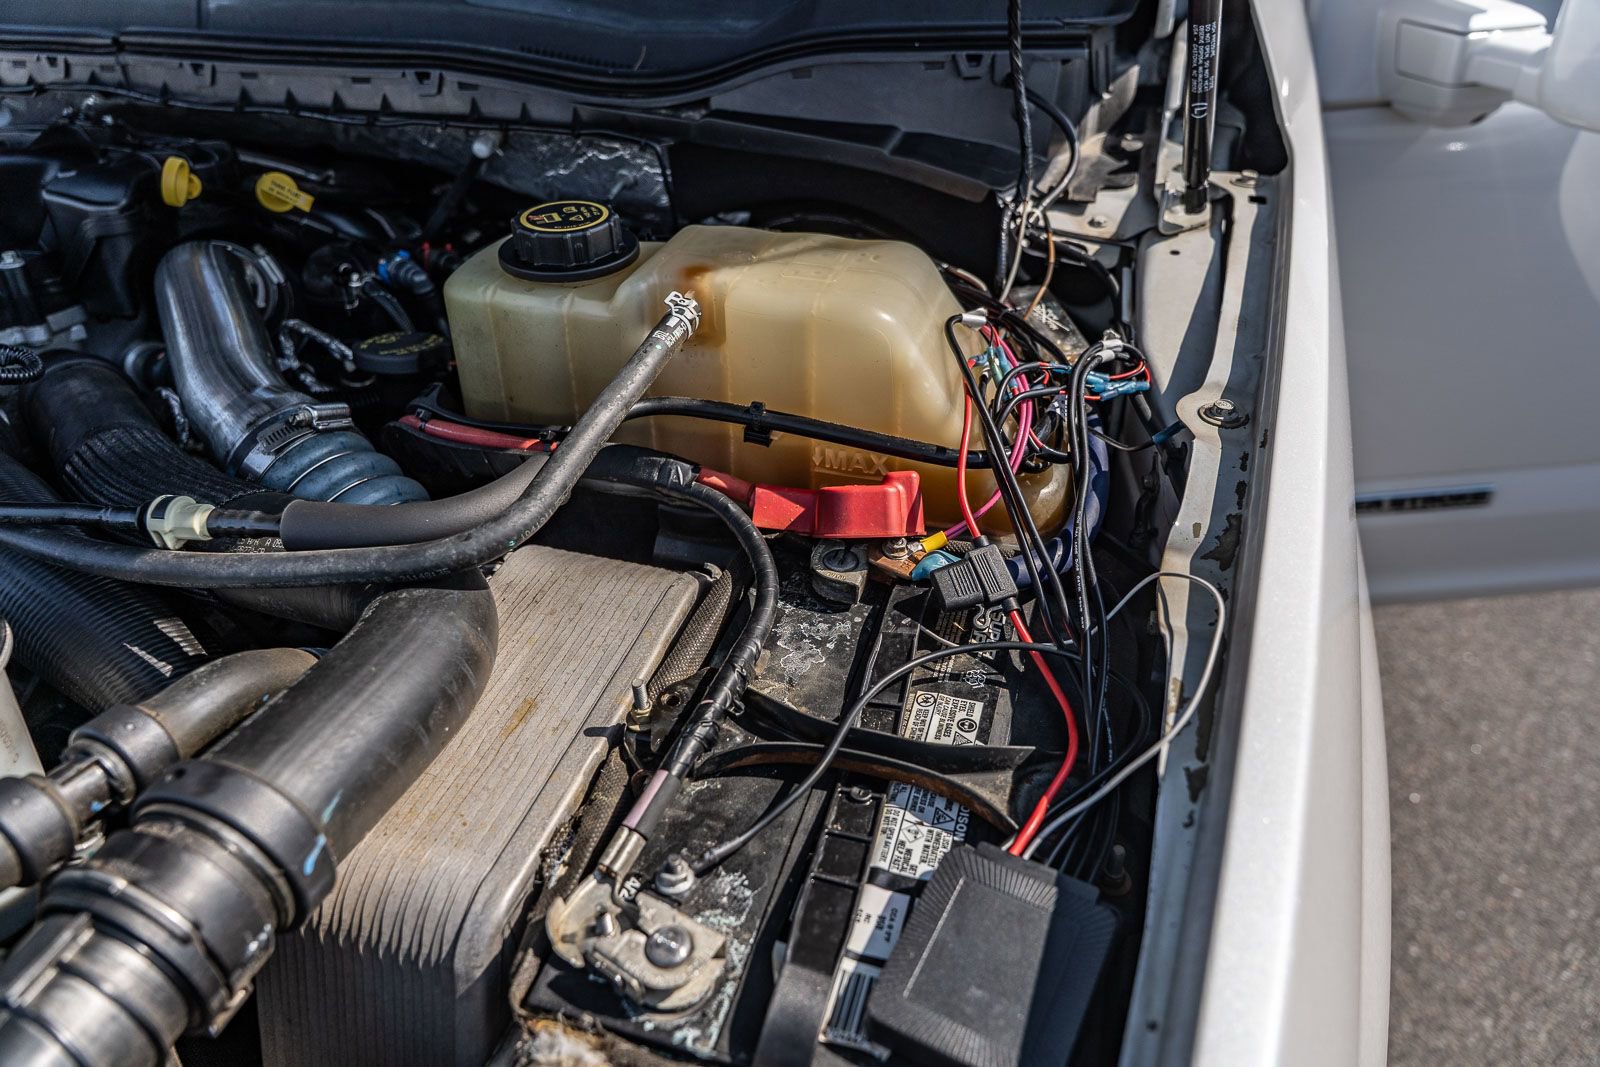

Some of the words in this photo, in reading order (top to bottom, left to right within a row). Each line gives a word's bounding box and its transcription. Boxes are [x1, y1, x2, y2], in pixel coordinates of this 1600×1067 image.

[825, 447, 889, 476] MAX
[914, 709, 923, 721] REACH
[941, 705, 949, 718] CAUSE
[948, 699, 959, 722] EXPLOSIVE
[966, 702, 976, 717] SHIELD
[935, 718, 945, 740] BLINDNESS
[944, 723, 953, 737] GASES
[955, 806, 970, 842] OISON
[886, 828, 895, 839] OPEN
[926, 829, 934, 842] WITH
[897, 840, 905, 854] HELP
[928, 832, 942, 867] IMMEDIATELY
[900, 849, 912, 871] MEDICAL
[909, 865, 917, 875] GET
